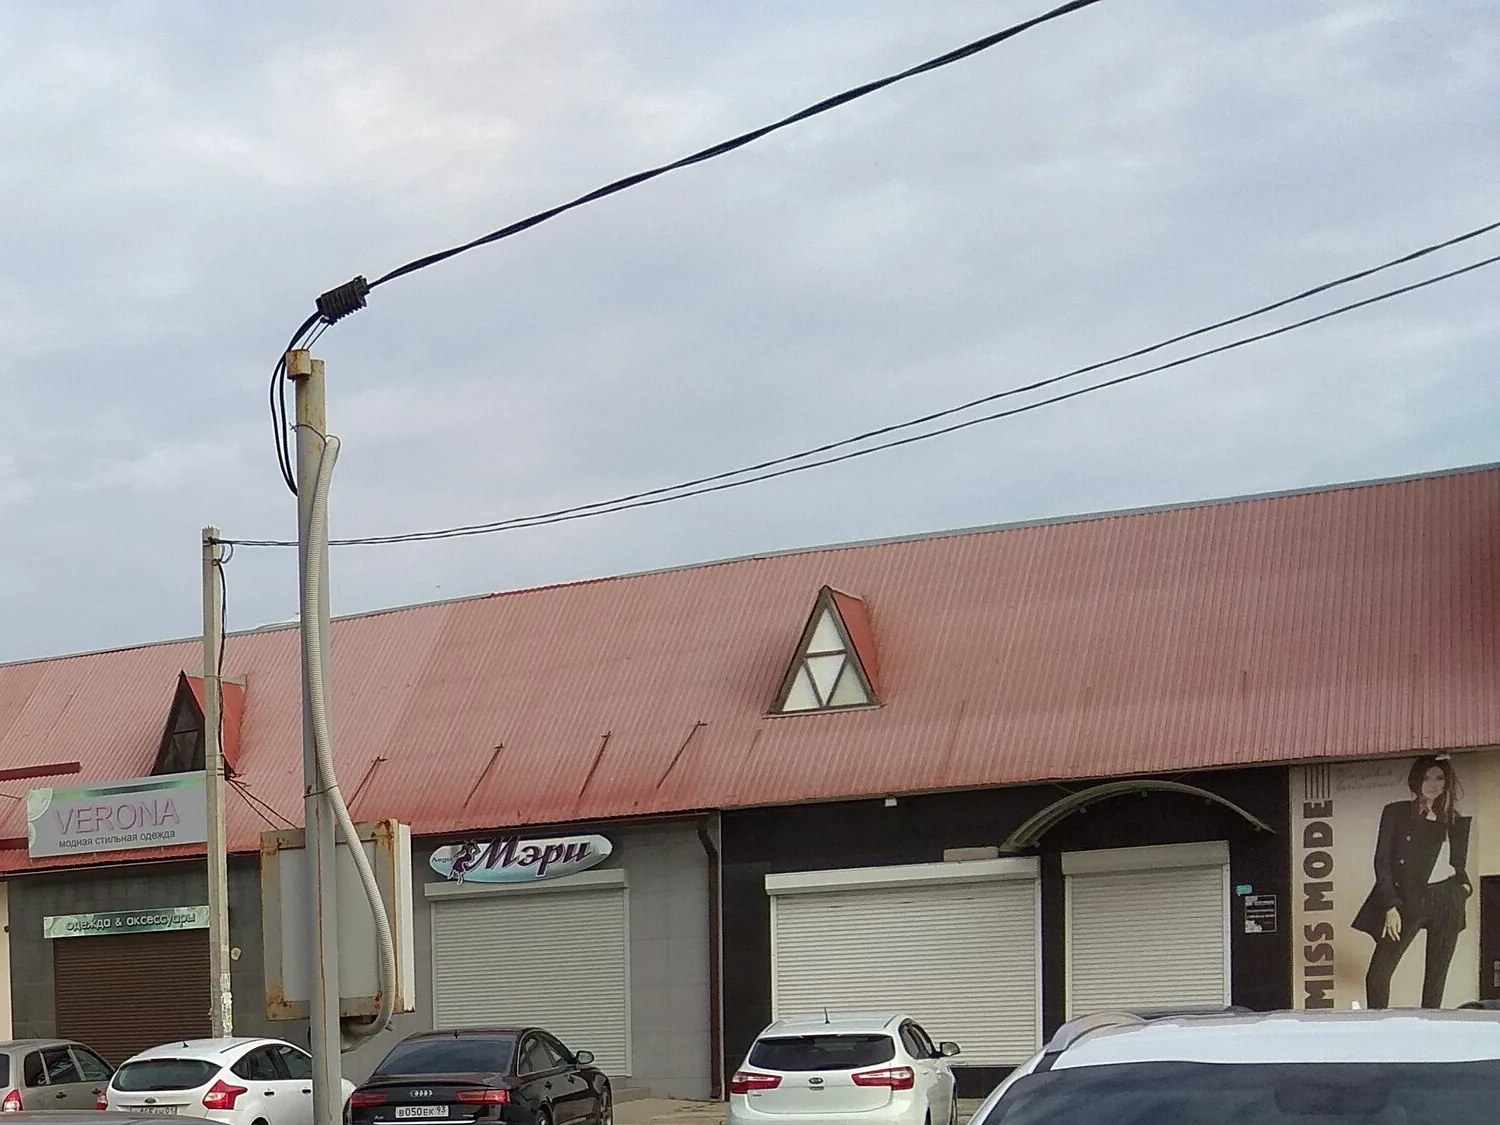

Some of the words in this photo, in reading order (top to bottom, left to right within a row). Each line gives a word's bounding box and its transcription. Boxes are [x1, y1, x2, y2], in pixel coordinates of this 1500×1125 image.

[56, 798, 181, 835] VERONA
[58, 838, 93, 849] модная
[95, 834, 138, 846] стильная
[140, 830, 176, 842] одежда
[469, 835, 592, 878] Мэри
[1303, 800, 1334, 912] MODE
[66, 917, 112, 932] одежда
[115, 916, 123, 927] &
[126, 912, 196, 929] аксессуары
[1304, 921, 1335, 1010] MISS
[437, 1105, 446, 1113] 93
